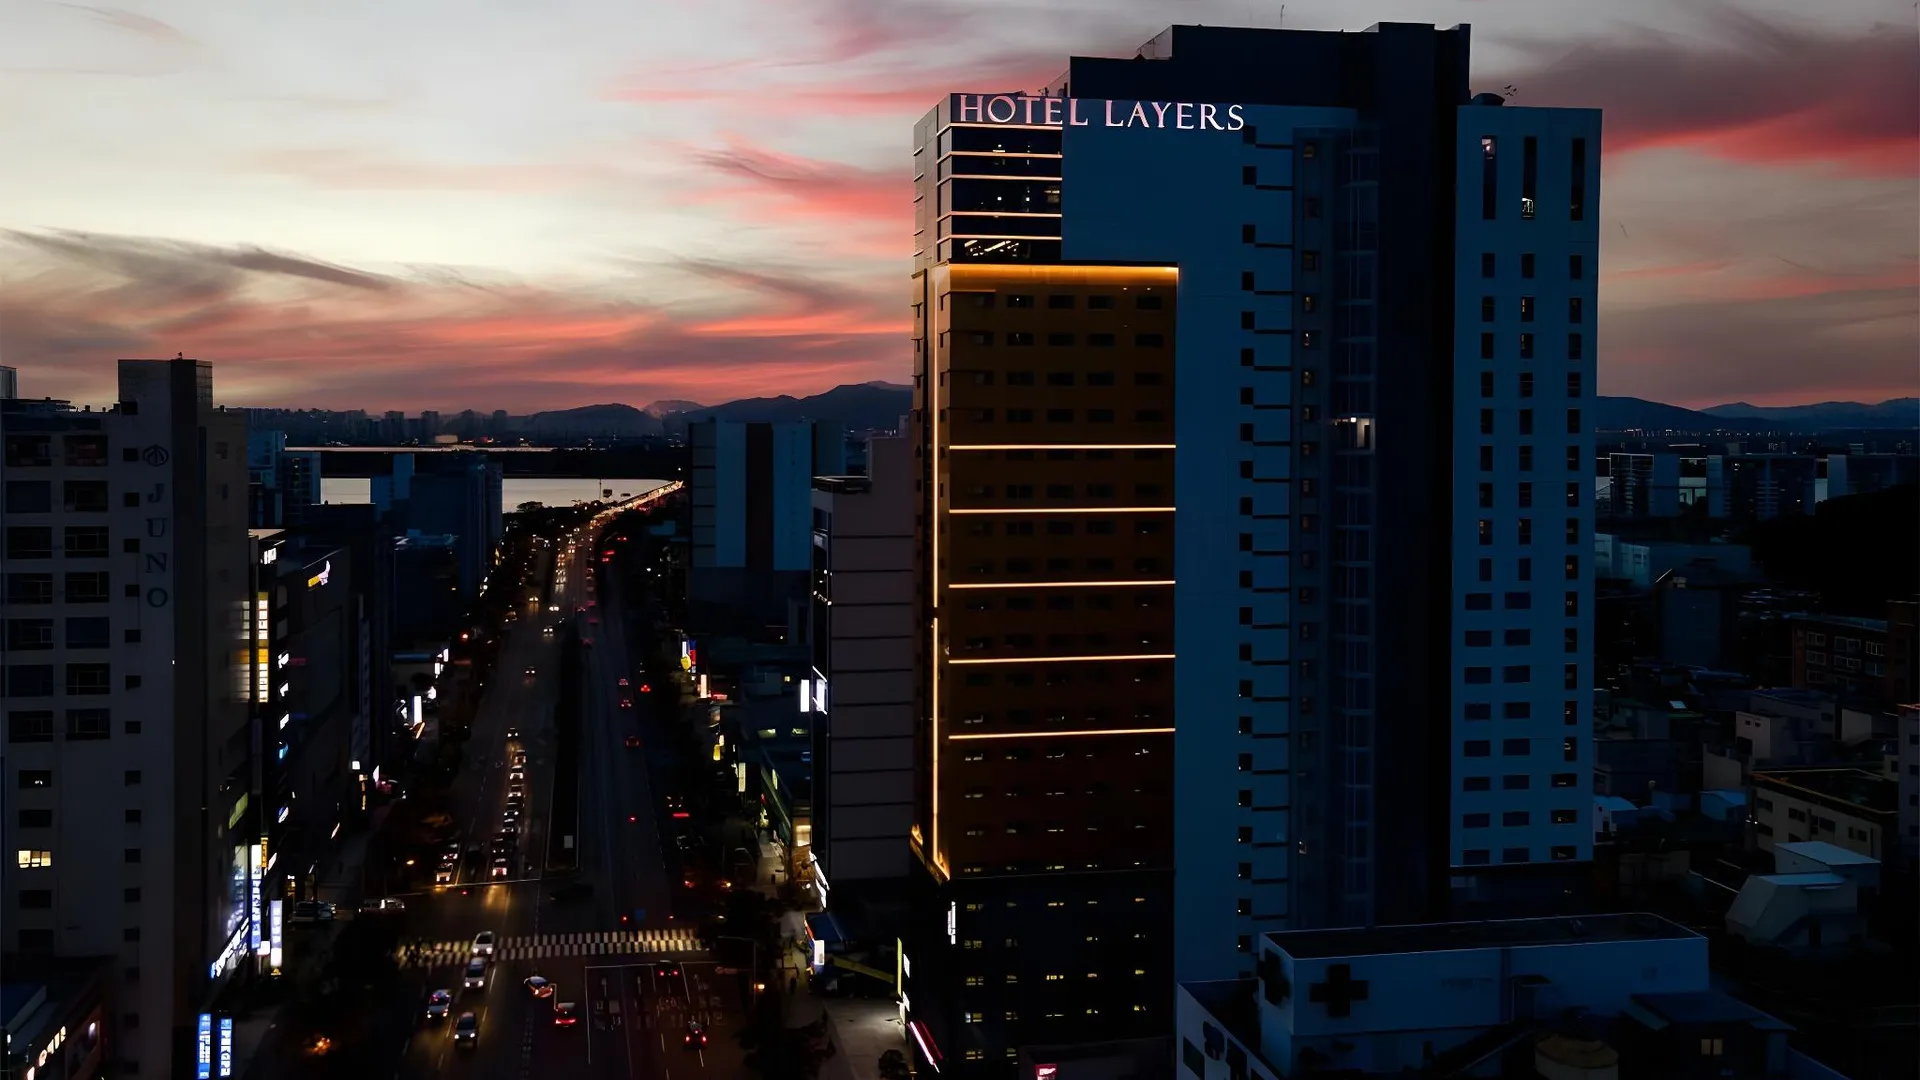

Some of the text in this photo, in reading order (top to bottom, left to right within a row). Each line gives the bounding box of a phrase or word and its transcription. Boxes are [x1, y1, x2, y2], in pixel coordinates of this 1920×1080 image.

[959, 94, 1245, 131] HOTEL LAYERS
[144, 483, 169, 608] JUNO
